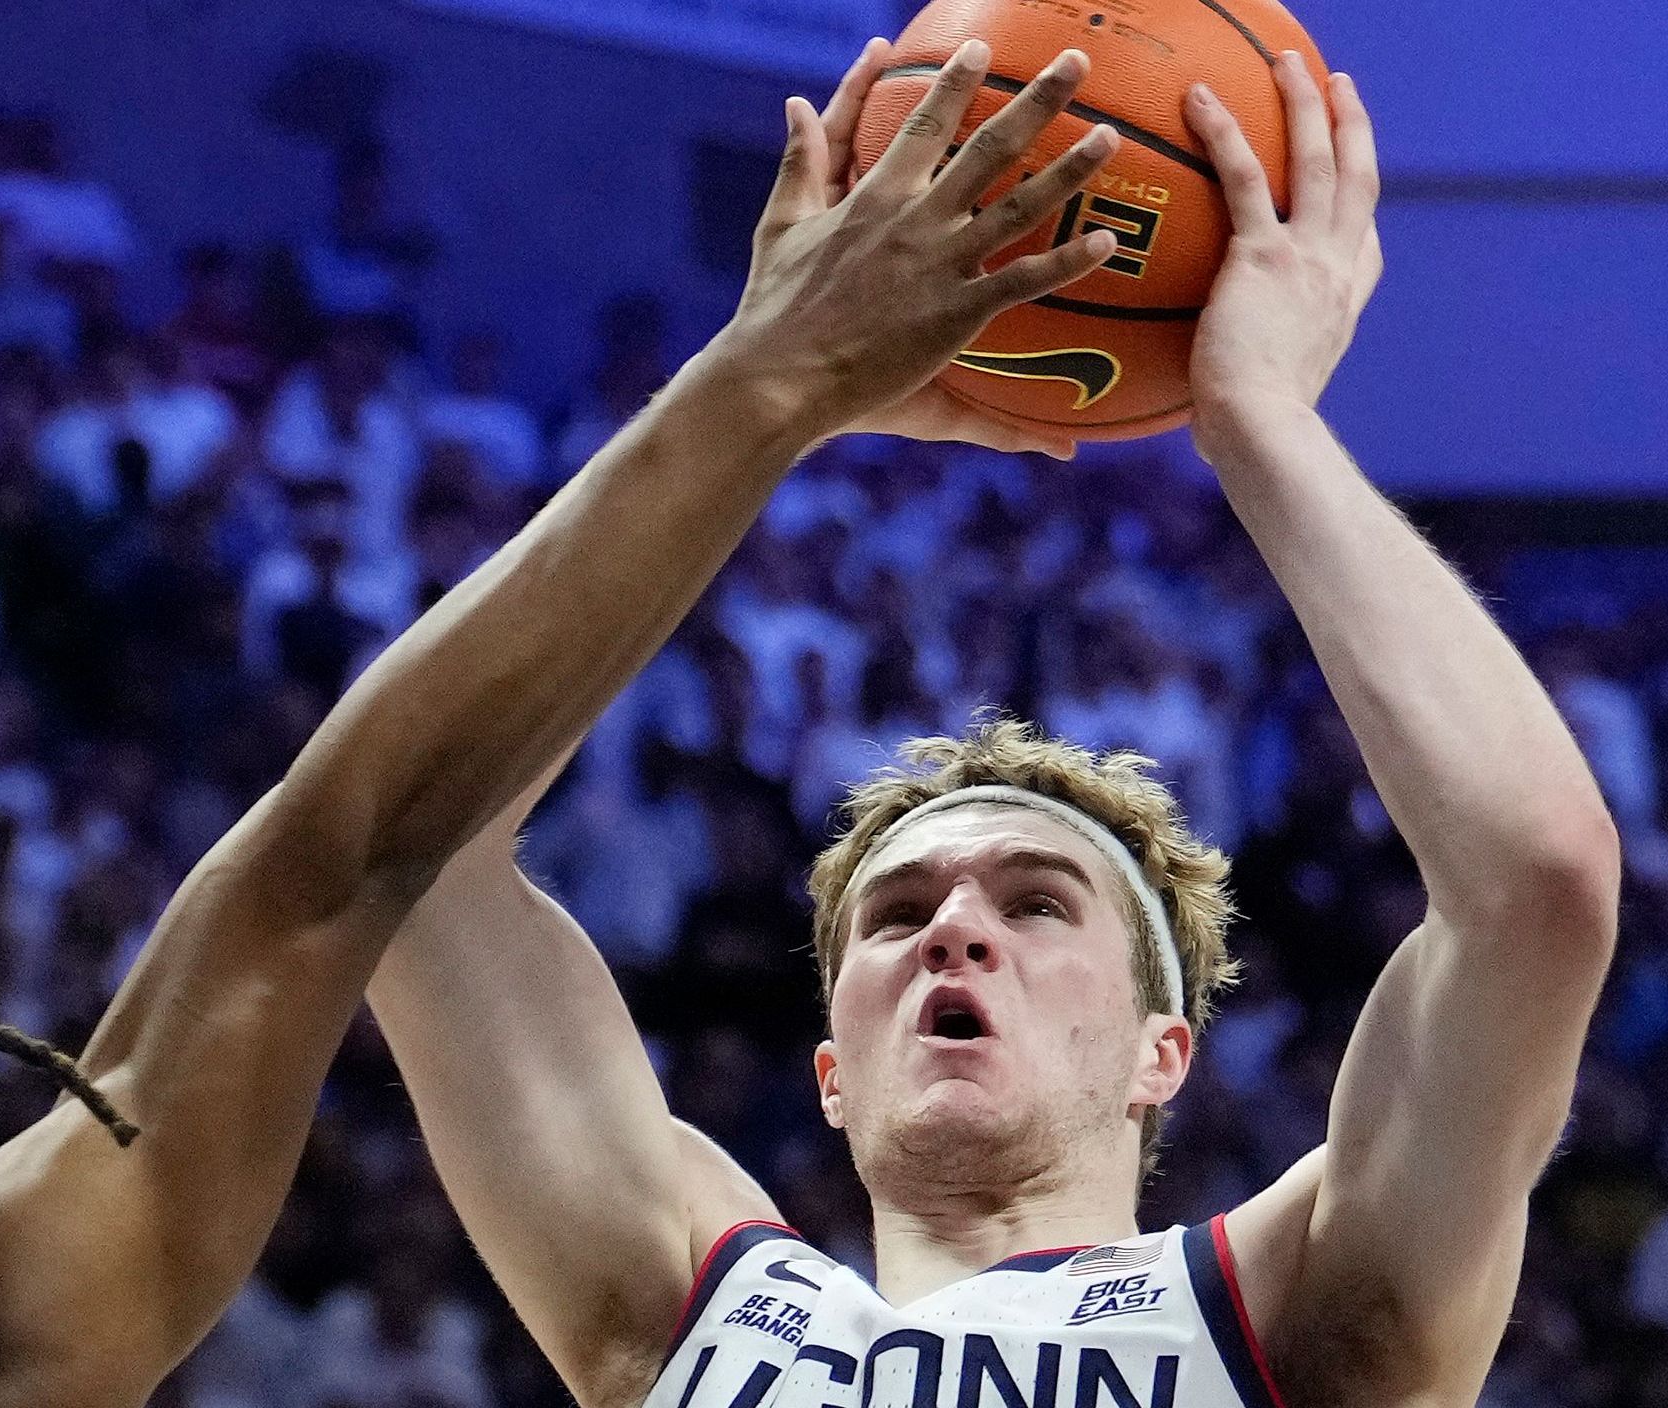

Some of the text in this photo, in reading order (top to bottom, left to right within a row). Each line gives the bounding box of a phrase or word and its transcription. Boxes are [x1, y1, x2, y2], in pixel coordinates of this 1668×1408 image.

[1070, 1287, 1168, 1319] EAST
[1081, 1272, 1151, 1301] BIG
[723, 1308, 805, 1348] CHANG
[741, 1294, 811, 1329] BE TH
